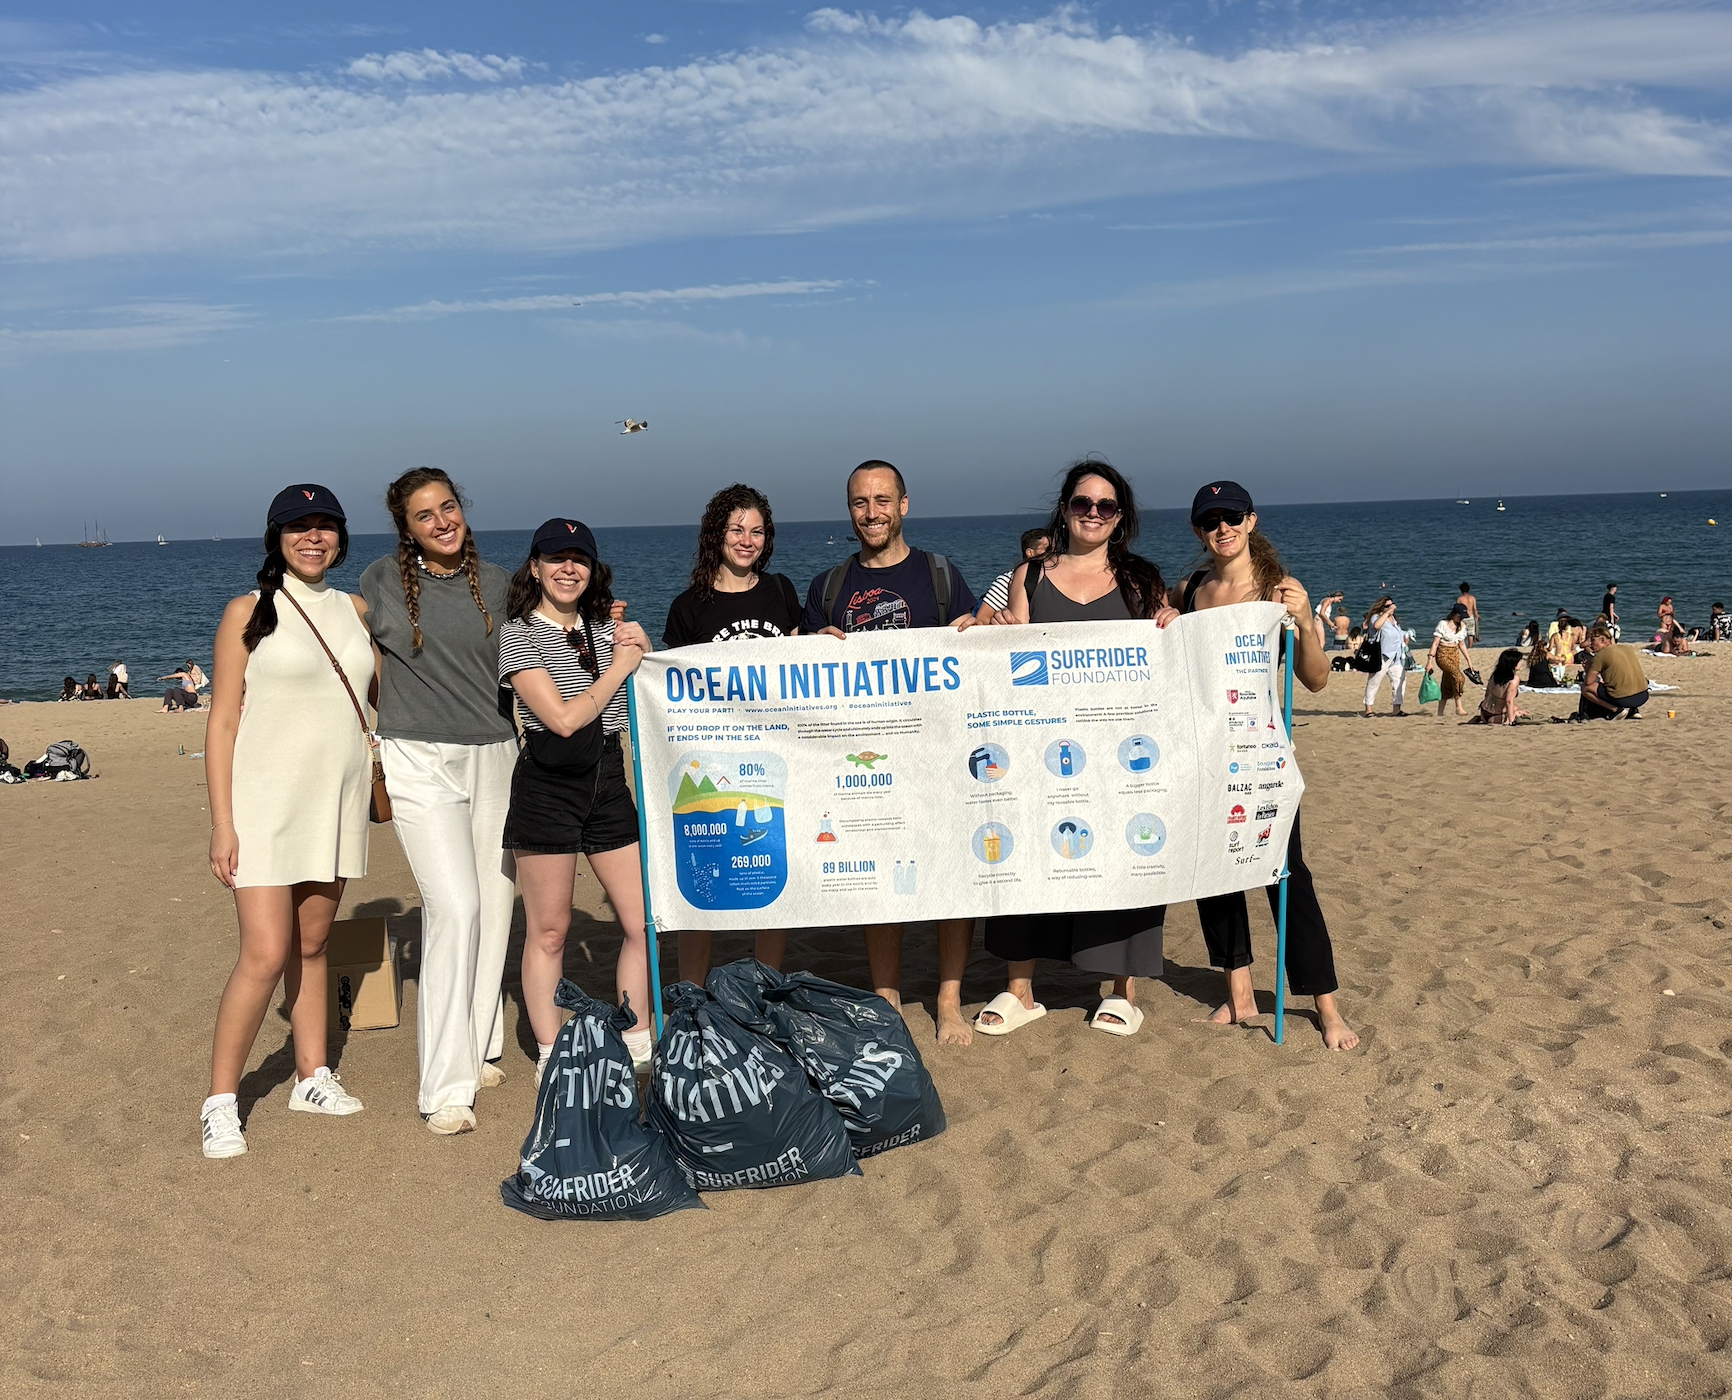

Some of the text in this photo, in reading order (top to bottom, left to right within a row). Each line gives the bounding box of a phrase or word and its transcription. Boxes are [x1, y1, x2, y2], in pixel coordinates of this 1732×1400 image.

[848, 588, 883, 610] Lisboa
[731, 619, 759, 632] THE
[762, 621, 784, 638] BR
[1051, 647, 1148, 670] SURFRIDER
[666, 656, 961, 702] OCEAN INITIATIVES
[1052, 670, 1150, 685] FOUNDATION
[744, 704, 838, 713] www.oceaninitiatives.org
[848, 700, 912, 709] #oceaninitiatives
[966, 710, 1000, 719] PLASTIC
[967, 721, 991, 730] SOME
[1025, 717, 1067, 725] GESTURES
[739, 763, 765, 776] 80%
[836, 773, 892, 789] 1,000,000
[1227, 782, 1253, 792] BALZAC
[683, 823, 727, 837] 8,000,000
[731, 854, 771, 869] 269,000
[822, 860, 876, 874] 89 BILLION
[696, 1146, 802, 1188] SURFRIDER
